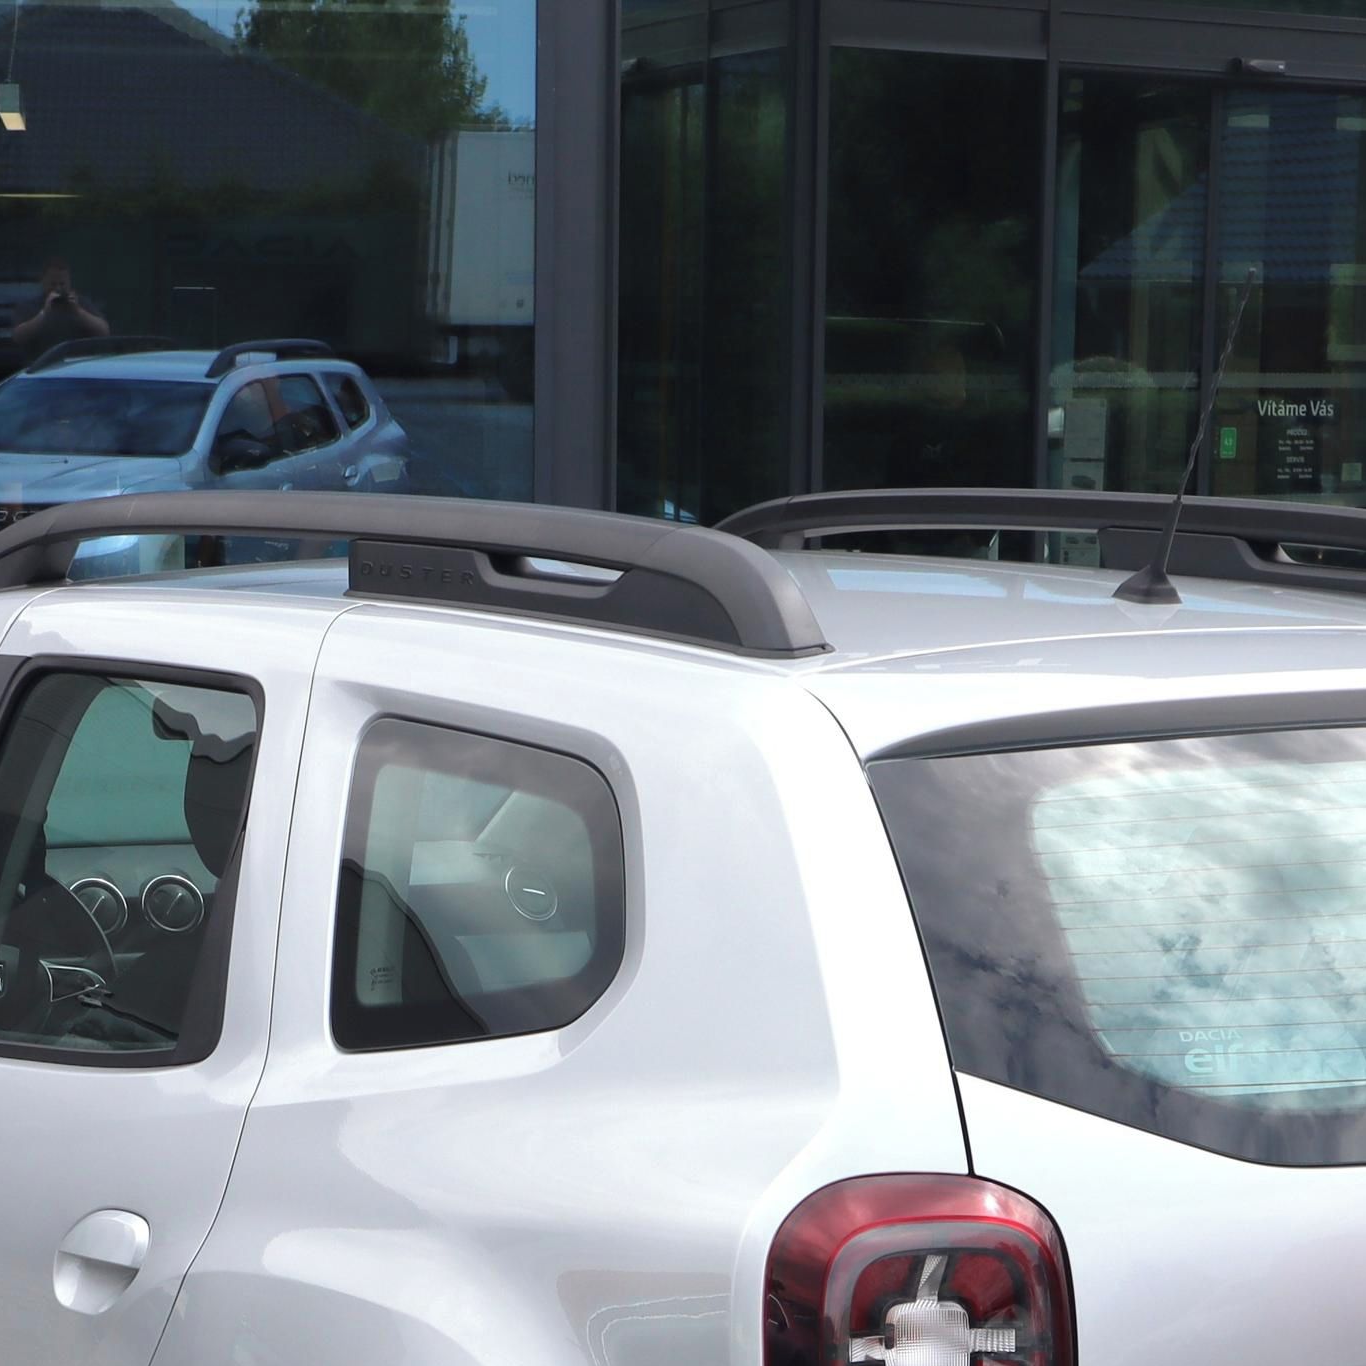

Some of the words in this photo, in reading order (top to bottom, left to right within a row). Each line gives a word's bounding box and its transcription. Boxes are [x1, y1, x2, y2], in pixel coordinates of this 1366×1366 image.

[1257, 399, 1307, 416] Vítáme
[1310, 399, 1335, 416] Vás
[361, 560, 475, 585] DUSTER
[1179, 1028, 1241, 1042] DACIA
